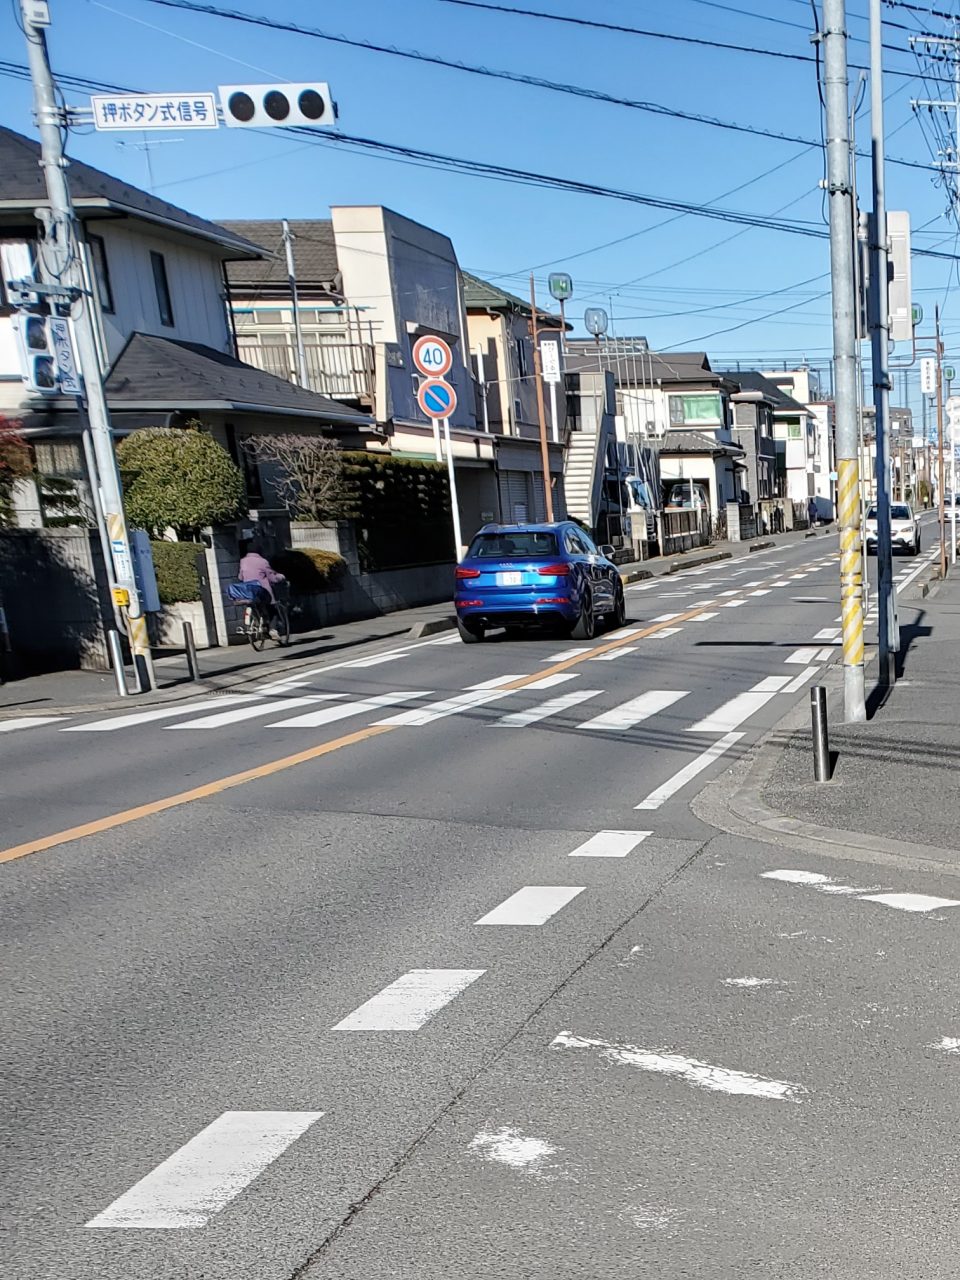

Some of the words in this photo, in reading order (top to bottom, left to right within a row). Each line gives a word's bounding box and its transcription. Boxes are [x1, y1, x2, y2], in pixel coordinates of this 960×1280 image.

[102, 101, 207, 122] 押ボタン式信号
[55, 323, 76, 389] 押ボタン式
[423, 348, 443, 365] 40
